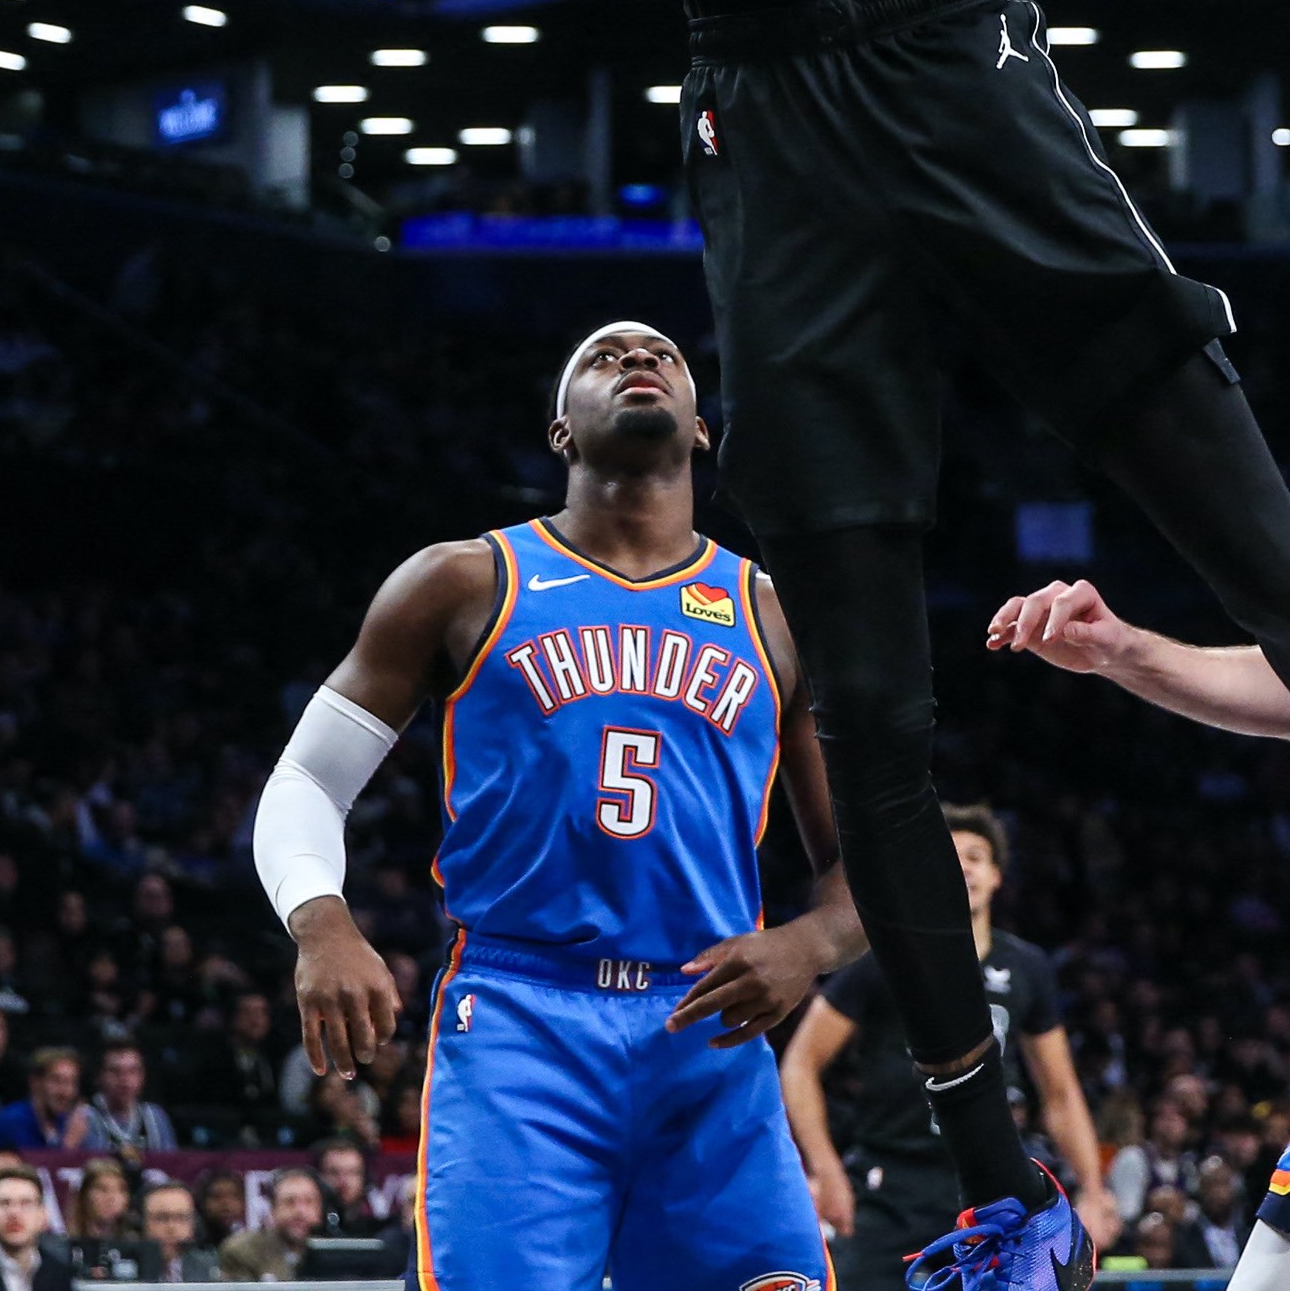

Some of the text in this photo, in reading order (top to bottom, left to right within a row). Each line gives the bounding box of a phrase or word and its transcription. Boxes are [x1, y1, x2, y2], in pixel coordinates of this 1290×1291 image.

[506, 624, 758, 737] THUNDER
[596, 724, 662, 840] 5
[597, 958, 651, 990] OKC
